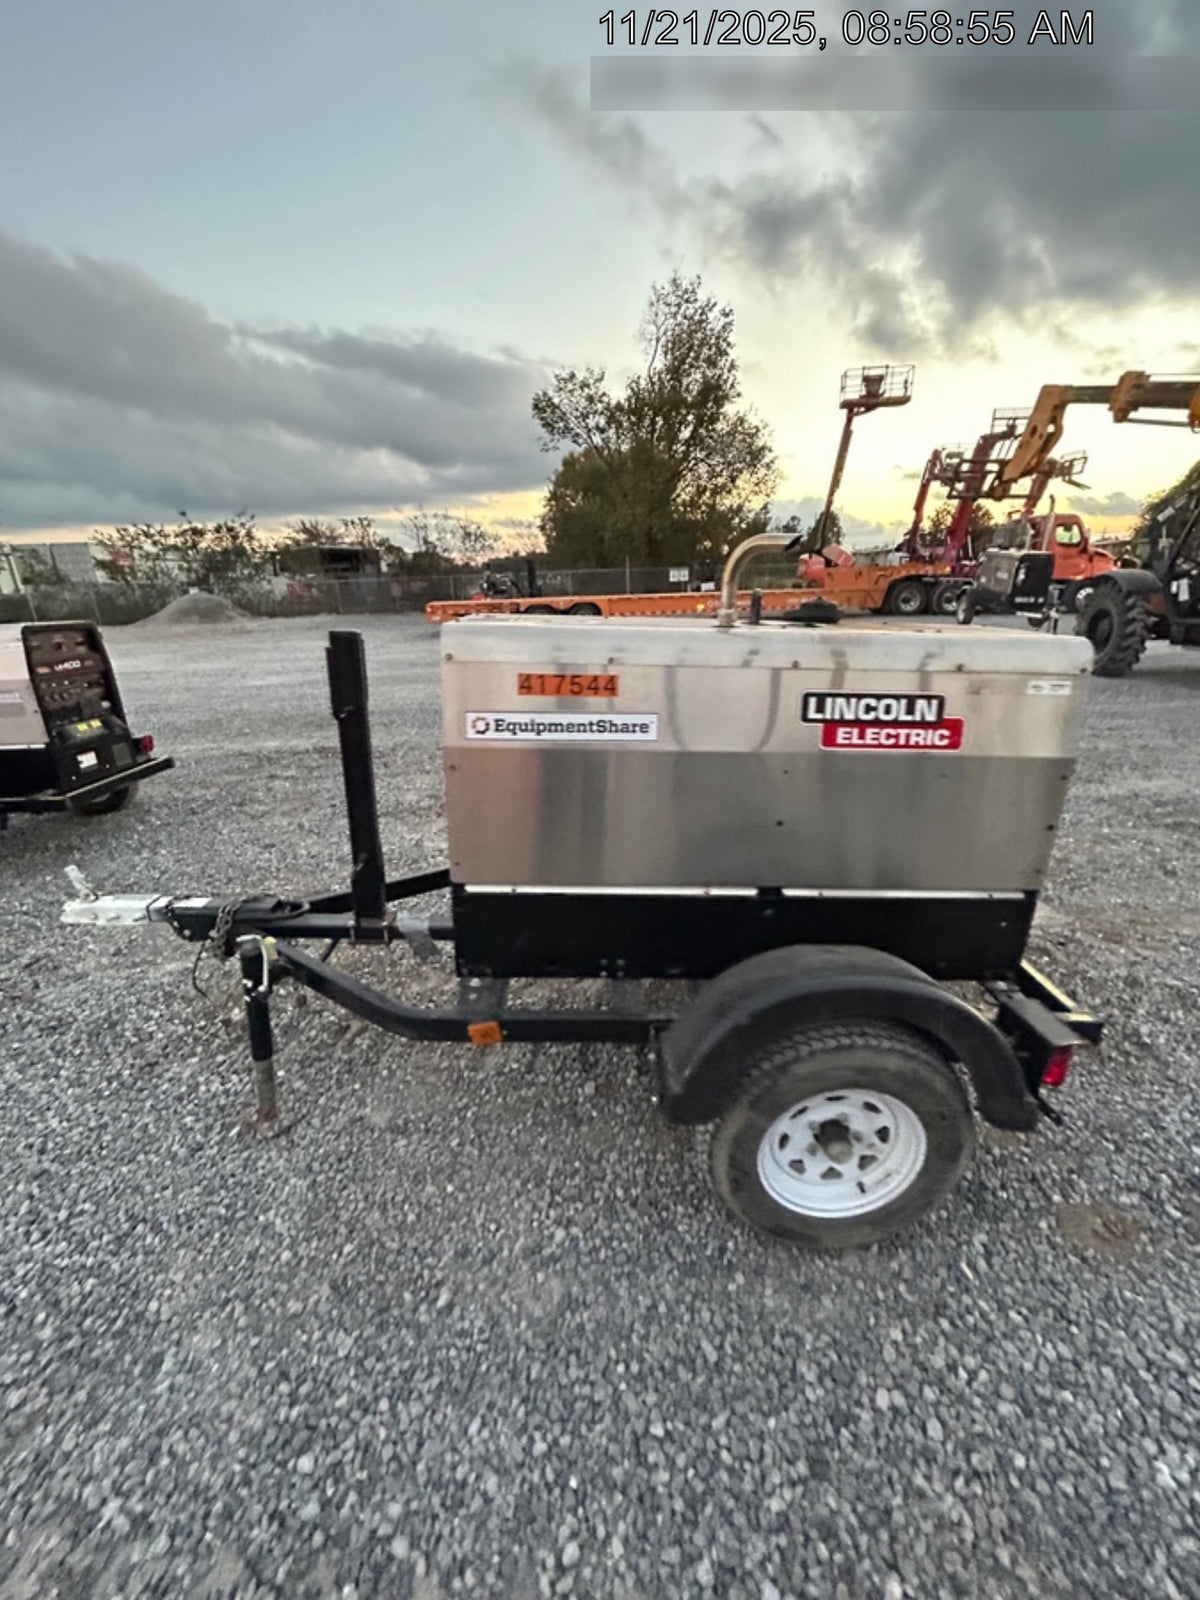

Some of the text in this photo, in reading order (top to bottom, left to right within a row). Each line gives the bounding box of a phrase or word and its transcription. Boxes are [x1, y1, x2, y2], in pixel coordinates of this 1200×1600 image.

[519, 675, 616, 695] 417544
[807, 697, 938, 722] LINCOLN
[494, 719, 650, 736] EquipmentShare
[836, 728, 950, 746] ELECTRIC
